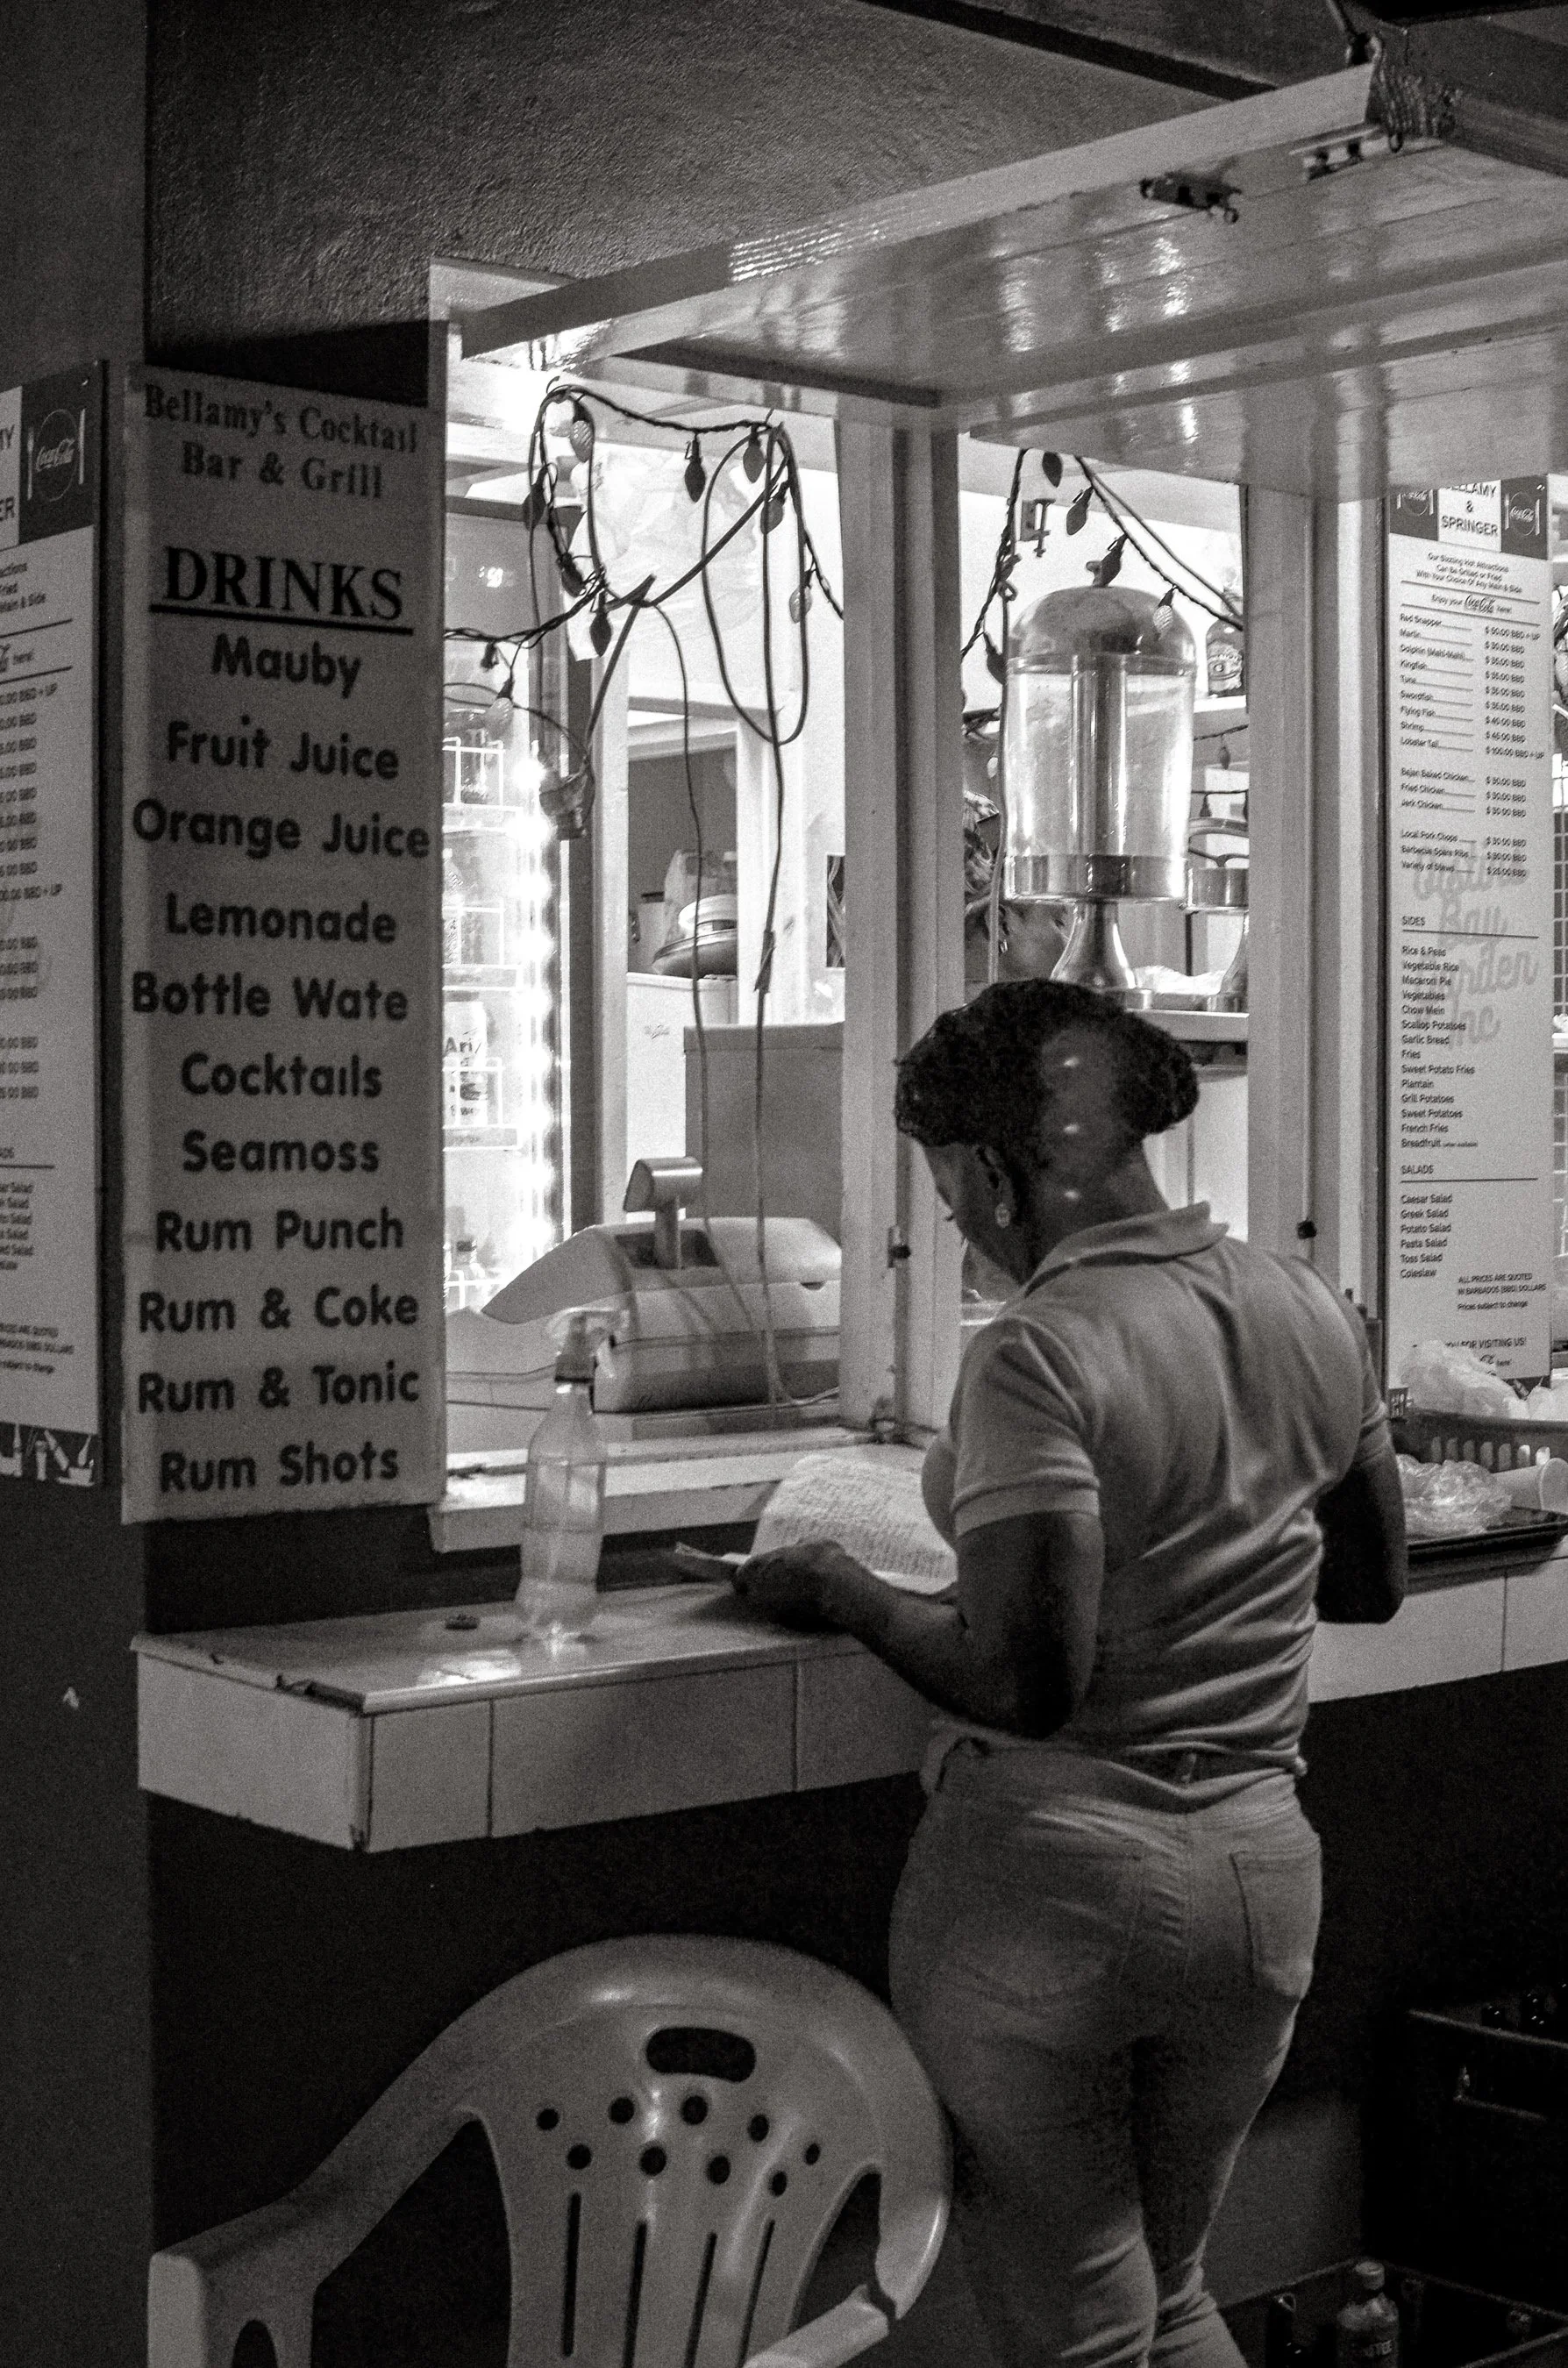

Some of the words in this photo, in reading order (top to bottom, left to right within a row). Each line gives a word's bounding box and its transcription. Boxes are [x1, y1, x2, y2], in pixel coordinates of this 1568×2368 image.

[145, 383, 287, 438] Bellamy's
[299, 406, 417, 453] Cocktail
[182, 440, 244, 481] Bar
[259, 451, 285, 486] &
[301, 456, 381, 499] Grill
[1466, 500, 1474, 514] &
[1442, 515, 1499, 537] SPRINGER
[163, 546, 403, 620] DRINKS
[1414, 616, 1442, 628] Snapper
[1401, 629, 1421, 638] Marlin
[1401, 645, 1426, 655] Dolphin
[210, 632, 361, 699] Mauby
[1401, 660, 1428, 671] Kingfish
[1401, 705, 1422, 717] Flying
[1422, 709, 1436, 717] Fish
[1401, 721, 1424, 732] Shrimp
[167, 714, 270, 769] Fruit
[289, 731, 400, 781] Juice
[1401, 737, 1426, 746] Lobster
[1401, 783, 1419, 793] Fried
[1420, 785, 1446, 795] Chicken
[1417, 800, 1443, 810] Chicken
[132, 798, 302, 859] Orange
[323, 811, 430, 858] Juice
[1401, 859, 1425, 872] Variety
[167, 891, 397, 944] Lemonade
[1401, 916, 1425, 927] SIDES
[1401, 945, 1419, 956] Rice
[1420, 946, 1426, 956] &
[1428, 947, 1447, 957] Peas
[1402, 960, 1441, 972] Vegetable
[1443, 962, 1460, 973] Rice
[1401, 976, 1436, 986] Macaroni
[1439, 976, 1452, 986] Pie
[132, 970, 271, 1017] Bottle
[293, 975, 409, 1022] Wate
[1402, 989, 1445, 1001] Vegetables
[1401, 1005, 1424, 1014] Chow
[1426, 1006, 1445, 1015] Mein
[1401, 1020, 1430, 1031] Scallop
[1432, 1021, 1466, 1031] Potatoes
[1401, 1034, 1424, 1044] Garlic
[1427, 1035, 1450, 1045] Bread
[1401, 1049, 1421, 1059] Fries
[181, 1052, 383, 1098] Cocktails
[1401, 1065, 1426, 1074] Sweet
[1428, 1065, 1455, 1074] Potato
[1456, 1065, 1475, 1074] Fries
[1401, 1079, 1434, 1088] Plantain
[1401, 1094, 1418, 1103] Grill
[1420, 1095, 1455, 1104] Potatoes
[1401, 1109, 1426, 1118] Sweet
[1428, 1109, 1464, 1119] Potatoes
[1401, 1123, 1428, 1133] French
[1429, 1123, 1449, 1133] Fries
[1401, 1138, 1441, 1148] Breadfruit
[182, 1129, 380, 1173] Seamoss
[1401, 1165, 1434, 1175] SALADS
[1401, 1194, 1429, 1204] Caesar
[1430, 1194, 1453, 1204] Salad
[1401, 1209, 1424, 1219] Greek
[1426, 1209, 1449, 1218] Salad
[156, 1209, 252, 1253] Rum
[275, 1205, 404, 1252] Punch
[1401, 1223, 1428, 1234] Potato
[1429, 1223, 1451, 1233] Salad
[1401, 1238, 1423, 1249] Pasta
[1424, 1238, 1448, 1248] Salad
[1401, 1253, 1419, 1264] Toss
[1420, 1252, 1443, 1263] Salad
[1401, 1268, 1437, 1279] Coleslaw
[1472, 1274, 1493, 1283] PRICES
[1493, 1273, 1507, 1282] ARE
[1465, 1285, 1500, 1295] BARBADOS
[1518, 1283, 1547, 1293] DOLLARS
[139, 1291, 236, 1333] Rum
[260, 1287, 292, 1330] &
[314, 1283, 419, 1329] Coke
[1479, 1337, 1513, 1350] VISITING
[139, 1372, 235, 1415] Rum
[258, 1366, 291, 1409] &
[312, 1359, 420, 1405] Tonic
[160, 1451, 256, 1494] Rum
[279, 1440, 399, 1487] Shots
